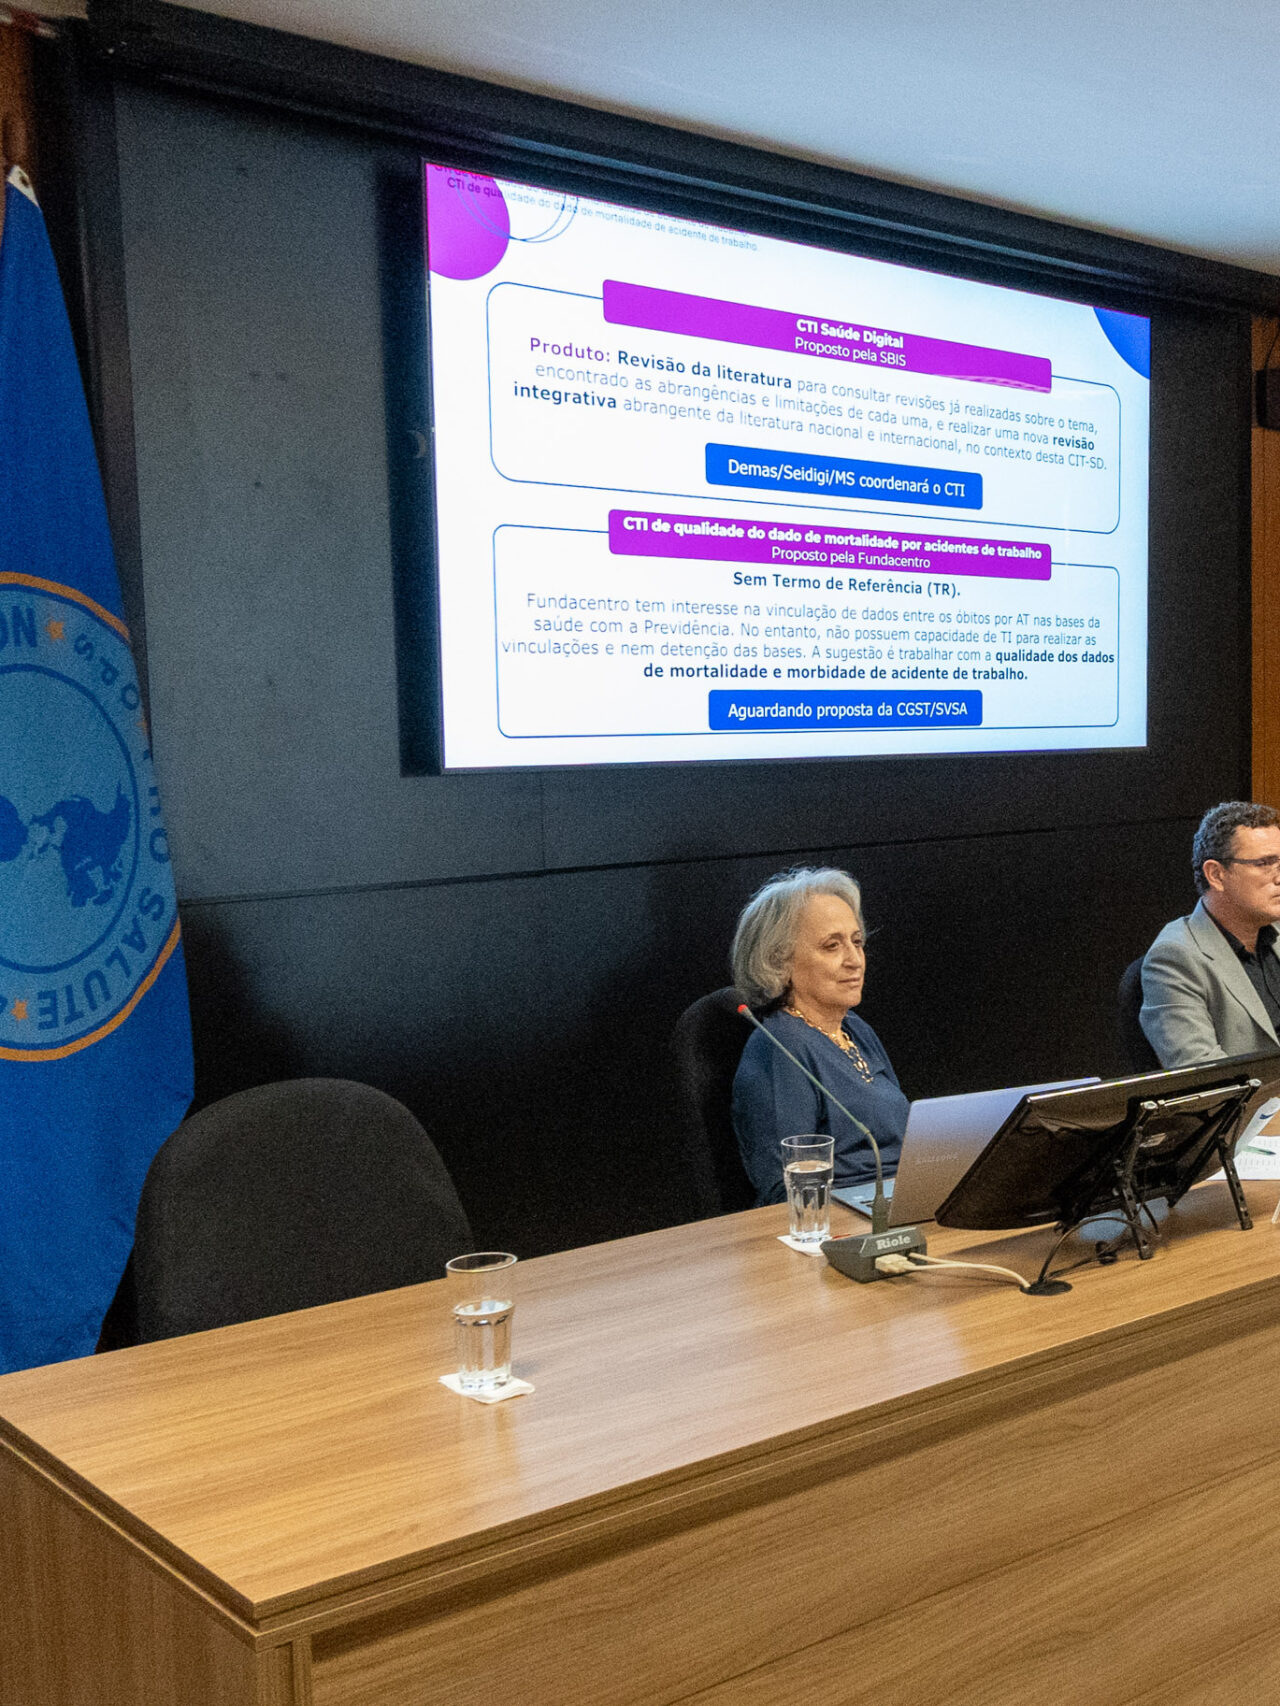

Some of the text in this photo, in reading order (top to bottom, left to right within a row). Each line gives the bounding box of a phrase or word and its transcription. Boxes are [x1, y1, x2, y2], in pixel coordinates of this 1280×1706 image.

[796, 318, 904, 349] CTI Saúde Digital
[794, 337, 907, 367] Proposto pela SBIS
[530, 338, 1098, 437] Produto: Revisão da literatura para consultar revisões já realizadas sobre o tema,
[535, 365, 1095, 451] encontrado as abrangências e limitações de cada uma, e realizar uma nova revisão
[514, 381, 1107, 470] integrativa abrangente da literatura nacional e internacional, no contexto desta CIT-SD.
[728, 460, 966, 497] Demas/Seidigi/MS coordenará o CTI
[623, 517, 1042, 560] CTI de qualidade do dado de mortalidade por acidentes de trabalho
[771, 546, 931, 568] Proposto pela Fundacentro
[733, 572, 961, 599] Sem Termo de Referência (TR).
[526, 593, 1101, 629] Fundacentro tem interesse na vinculação de dados entre os óbitos por AT nas bases da
[533, 615, 1097, 648] saúde com a Previdência. No entanto, não possuem capacidade de TI para realizar as
[501, 639, 1115, 665] vinculações e nem detenção das bases. A sugestão é trabalhar com a qualidade dos dados
[643, 663, 1028, 680] de mortalidade e morbidade de acidente de trabalho.
[728, 701, 968, 721] Aguardando proposta da CGST/SVSA
[37, 886, 165, 1031] SALUTE
[876, 1234, 912, 1250] Riole
